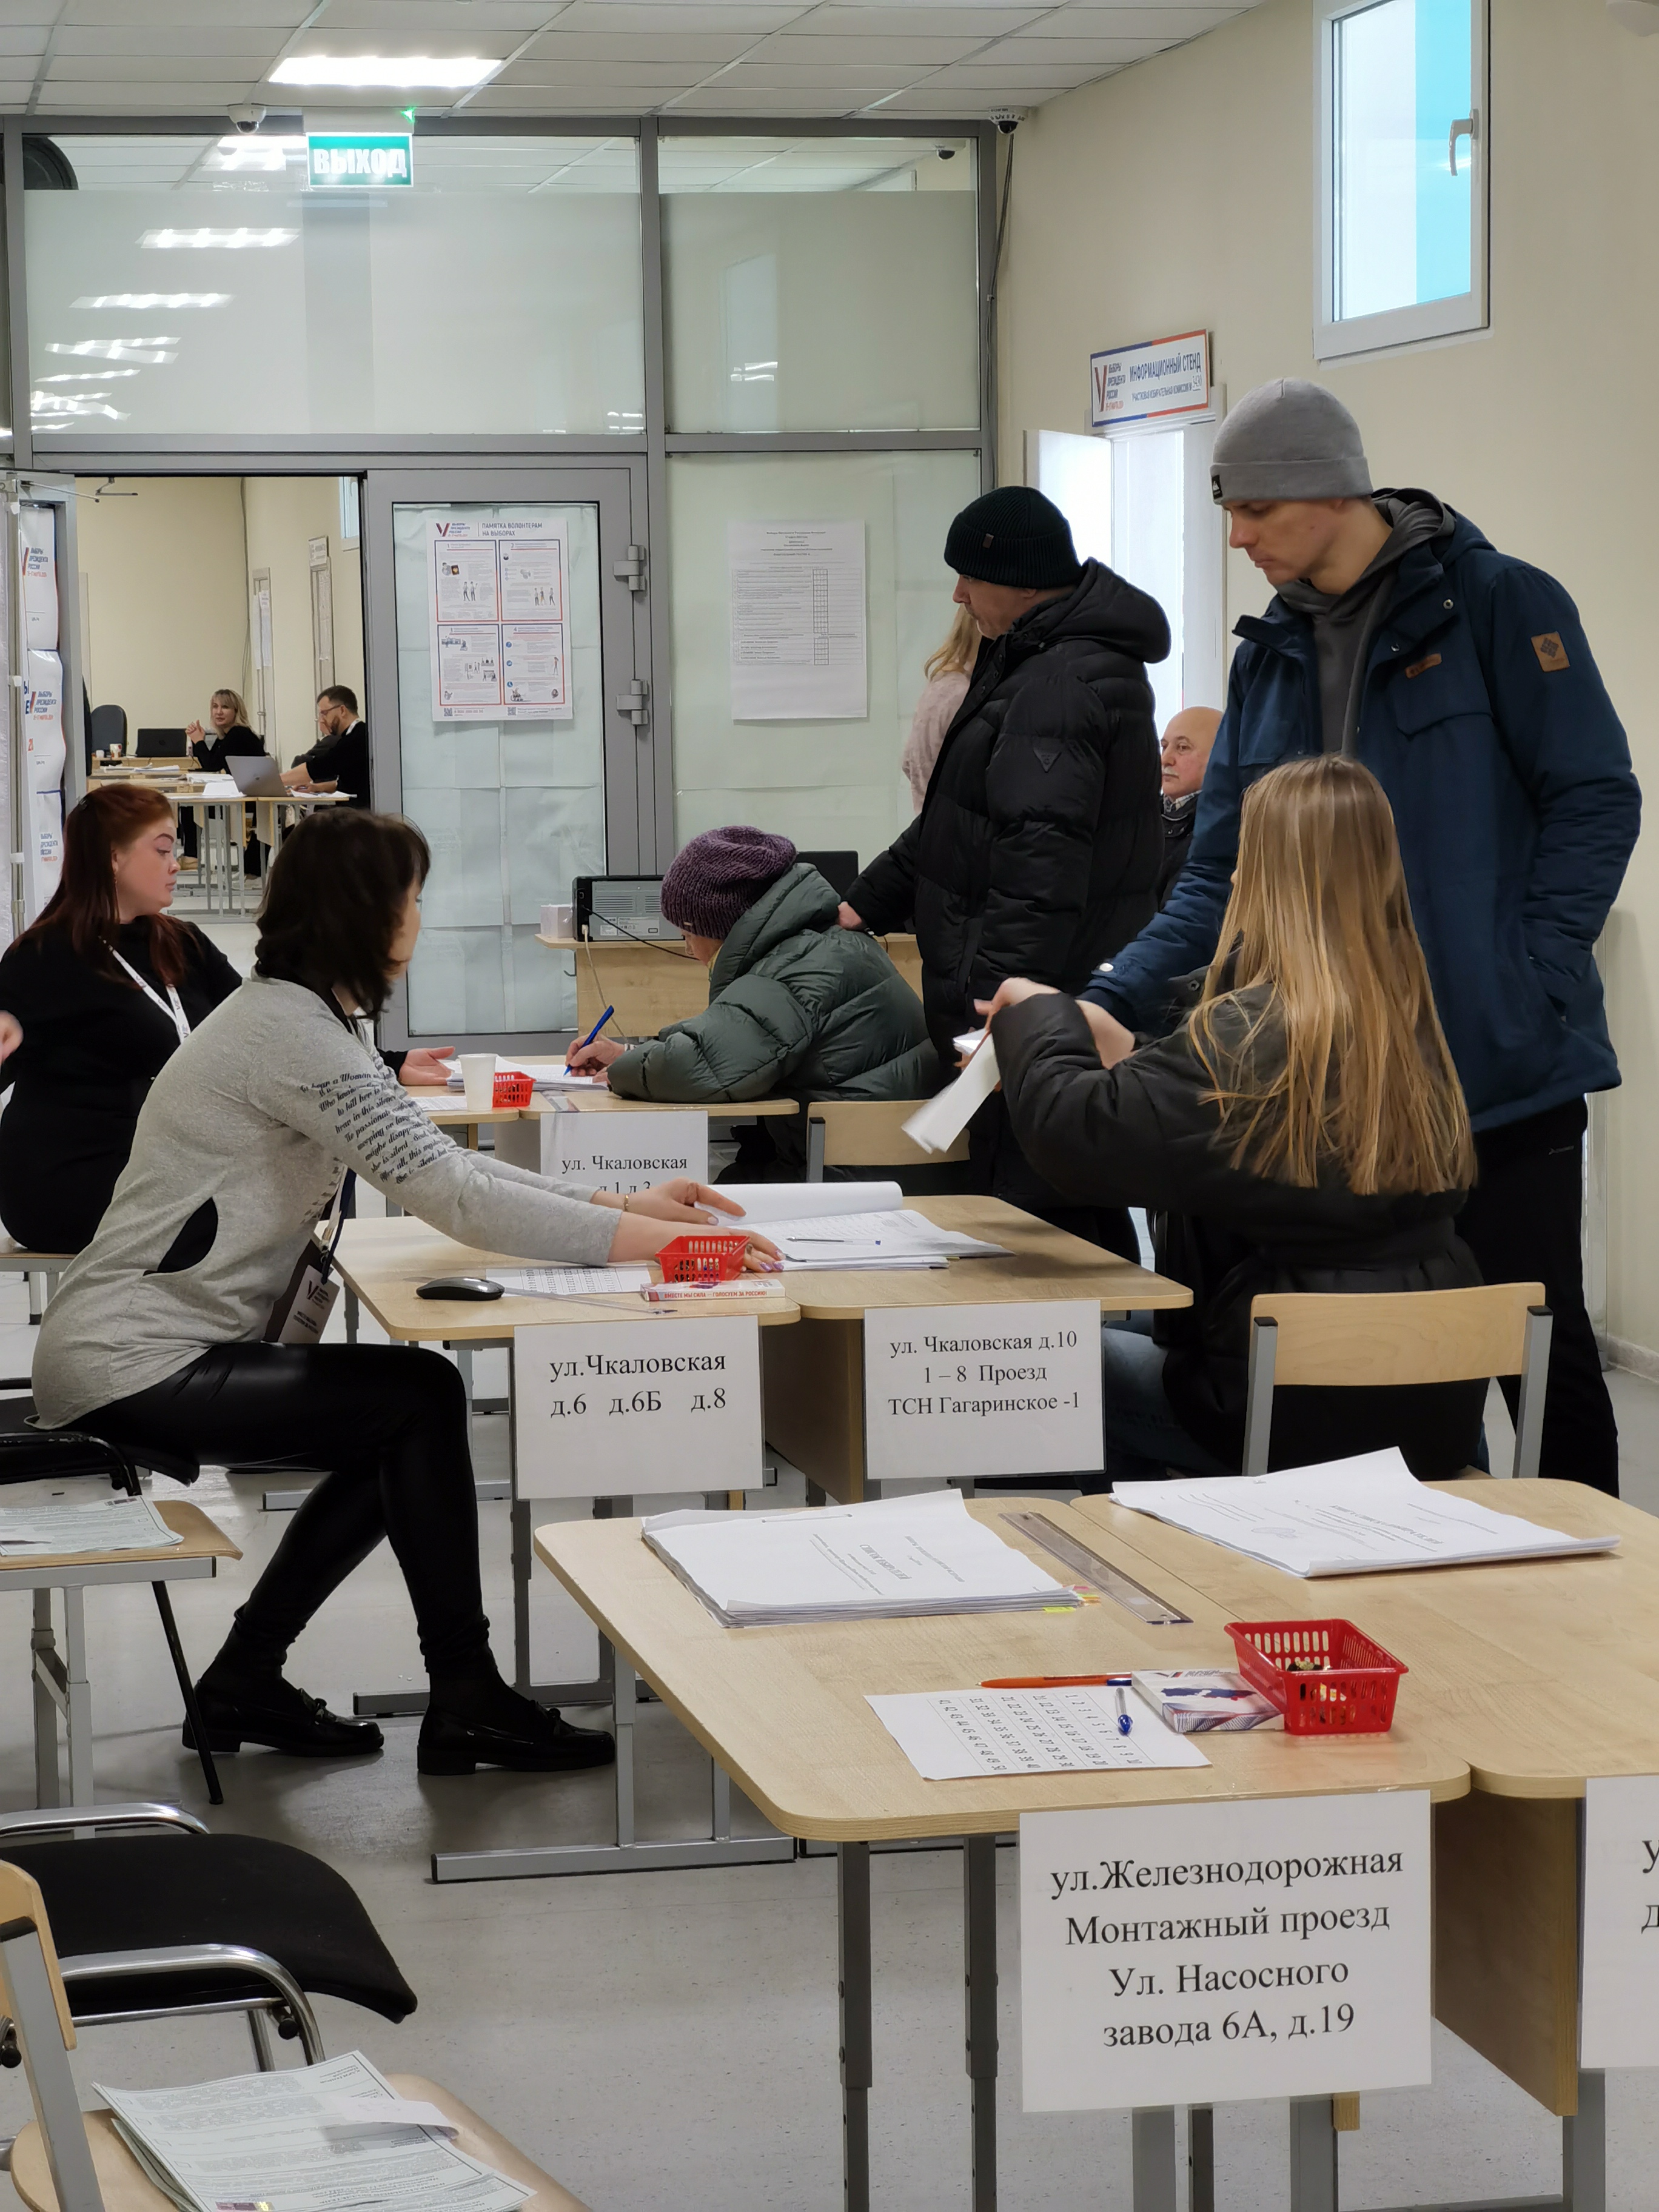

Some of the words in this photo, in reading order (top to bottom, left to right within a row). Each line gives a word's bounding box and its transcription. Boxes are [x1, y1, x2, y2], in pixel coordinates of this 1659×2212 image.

[313, 148, 407, 178] ВЫХОД
[1130, 352, 1181, 382] ИНФОРМАЦИОННЫЙ
[1182, 352, 1201, 372] СТЕНД
[340, 1073, 371, 1082] Woman
[562, 1161, 585, 1174] ул.
[593, 1156, 686, 1169] Чкаловская
[890, 1342, 917, 1358] ул.
[925, 1336, 1031, 1352] Чкаловская
[1039, 1331, 1076, 1350] д.10
[550, 1355, 725, 1382] ул.Чкаловская
[926, 1367, 930, 1382] 1
[957, 1366, 966, 1381] 8
[979, 1365, 1047, 1385] Проезд
[551, 1394, 586, 1418] д.6
[609, 1391, 661, 1415] д.6Б
[691, 1388, 725, 1412] д.8
[888, 1398, 931, 1415] ТСН
[940, 1398, 1057, 1416] Гагаринское
[1051, 1853, 1403, 1900] ул.Железнодорожная
[1067, 1907, 1267, 1945] Монтажный
[1281, 1908, 1389, 1940] проезд
[1110, 1968, 1163, 1996] Ул.
[1178, 1963, 1348, 1992] Насосного
[1104, 2022, 1212, 2046] завода
[1223, 2011, 1276, 2042] 6А,
[1289, 2004, 1353, 2039] д.19
